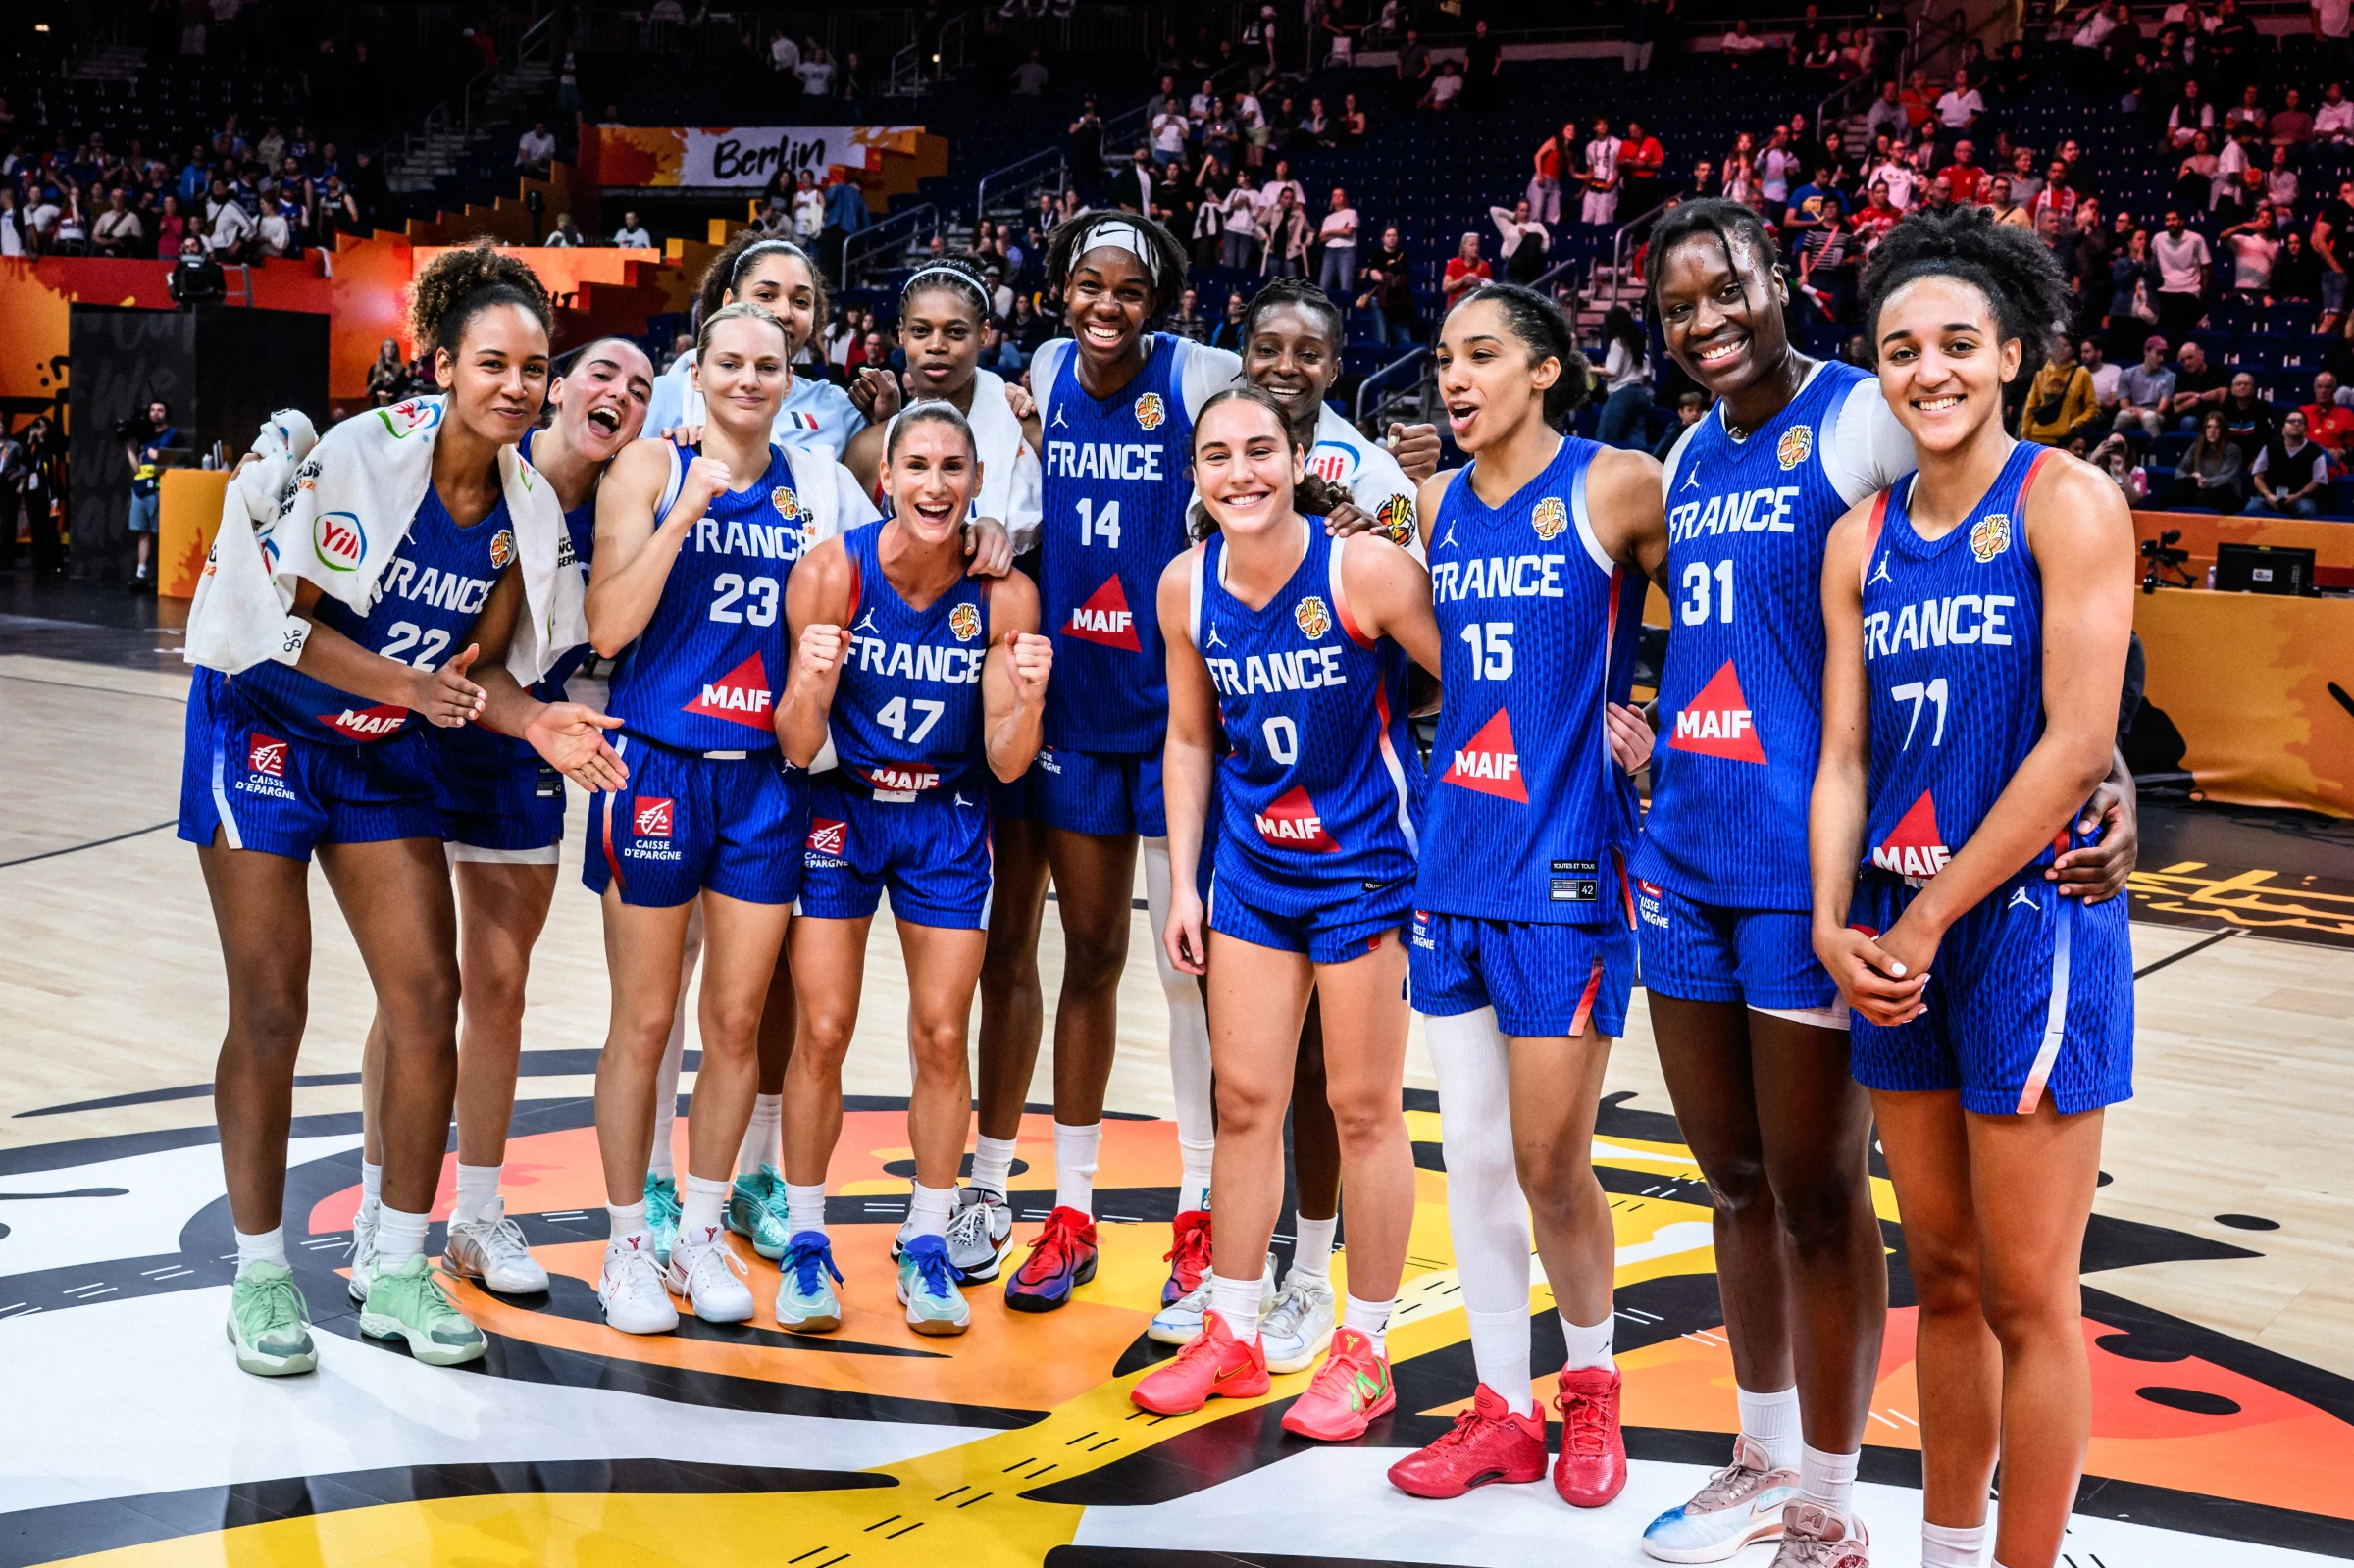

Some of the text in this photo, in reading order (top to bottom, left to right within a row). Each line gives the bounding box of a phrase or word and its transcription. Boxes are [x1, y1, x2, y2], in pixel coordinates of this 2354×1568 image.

[713, 135, 825, 179] Berlin
[1047, 441, 1163, 481] FRANCE
[1313, 456, 1344, 481] ili
[1075, 497, 1120, 549] 14
[1668, 486, 1800, 550] FRANCE
[1432, 554, 1565, 606] FRANCE
[1681, 559, 1733, 627] 31
[709, 572, 780, 628] 23
[1072, 608, 1132, 633] MAIF
[379, 620, 451, 674] 22
[844, 634, 987, 684] FRANCE
[1460, 622, 1514, 681] 15
[1205, 645, 1347, 696] FRANCE
[702, 684, 771, 713] MAIF
[1891, 678, 1949, 752] 71
[335, 708, 407, 733] MAIF
[876, 696, 945, 744] 47
[1677, 710, 1753, 739] MAIF
[1262, 716, 1298, 766] 0
[249, 774, 284, 788] CAISSE
[871, 768, 940, 790] MAIF
[1455, 751, 1518, 780] MAIF
[234, 781, 296, 801] D'EPARGNE
[636, 839, 671, 850] CAISSE
[1255, 814, 1321, 840] MAIF
[624, 847, 682, 861] D'EPARGNE
[1873, 846, 1951, 876] MAIF
[1581, 885, 1594, 895] 42
